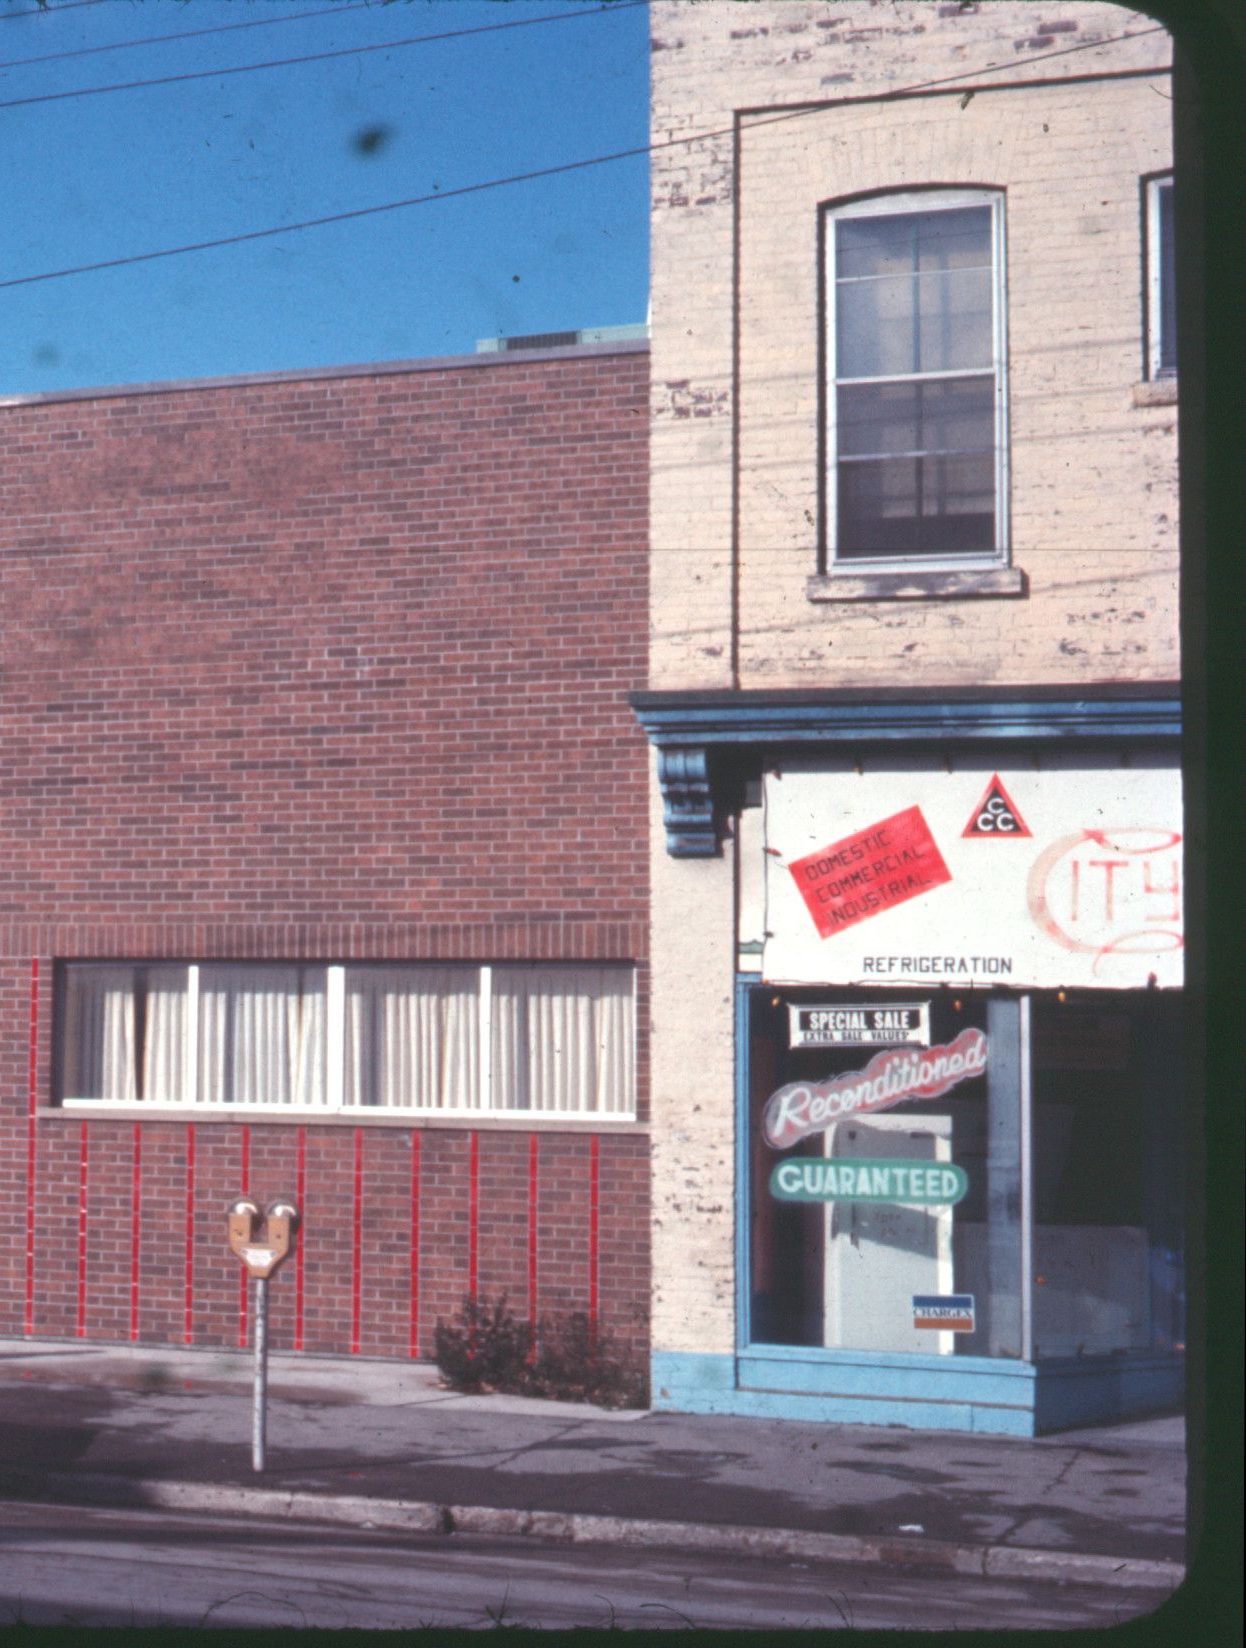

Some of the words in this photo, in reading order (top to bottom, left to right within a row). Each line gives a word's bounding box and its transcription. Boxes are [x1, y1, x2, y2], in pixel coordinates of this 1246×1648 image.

[804, 829, 890, 881] DOMESTIC
[816, 846, 925, 904] COMMERCIAL
[827, 876, 930, 927] INDUSTRIAL
[863, 956, 1013, 975] REFRIGERATION
[804, 1030, 834, 1041] EXTRA
[842, 1030, 863, 1041] SALE
[809, 1011, 867, 1030] SPECIAL
[874, 1010, 909, 1030] SALE
[773, 1034, 988, 1137] Reconditioned
[777, 1164, 959, 1197] GUARANTEED
[912, 1307, 972, 1319] CHARGEX
